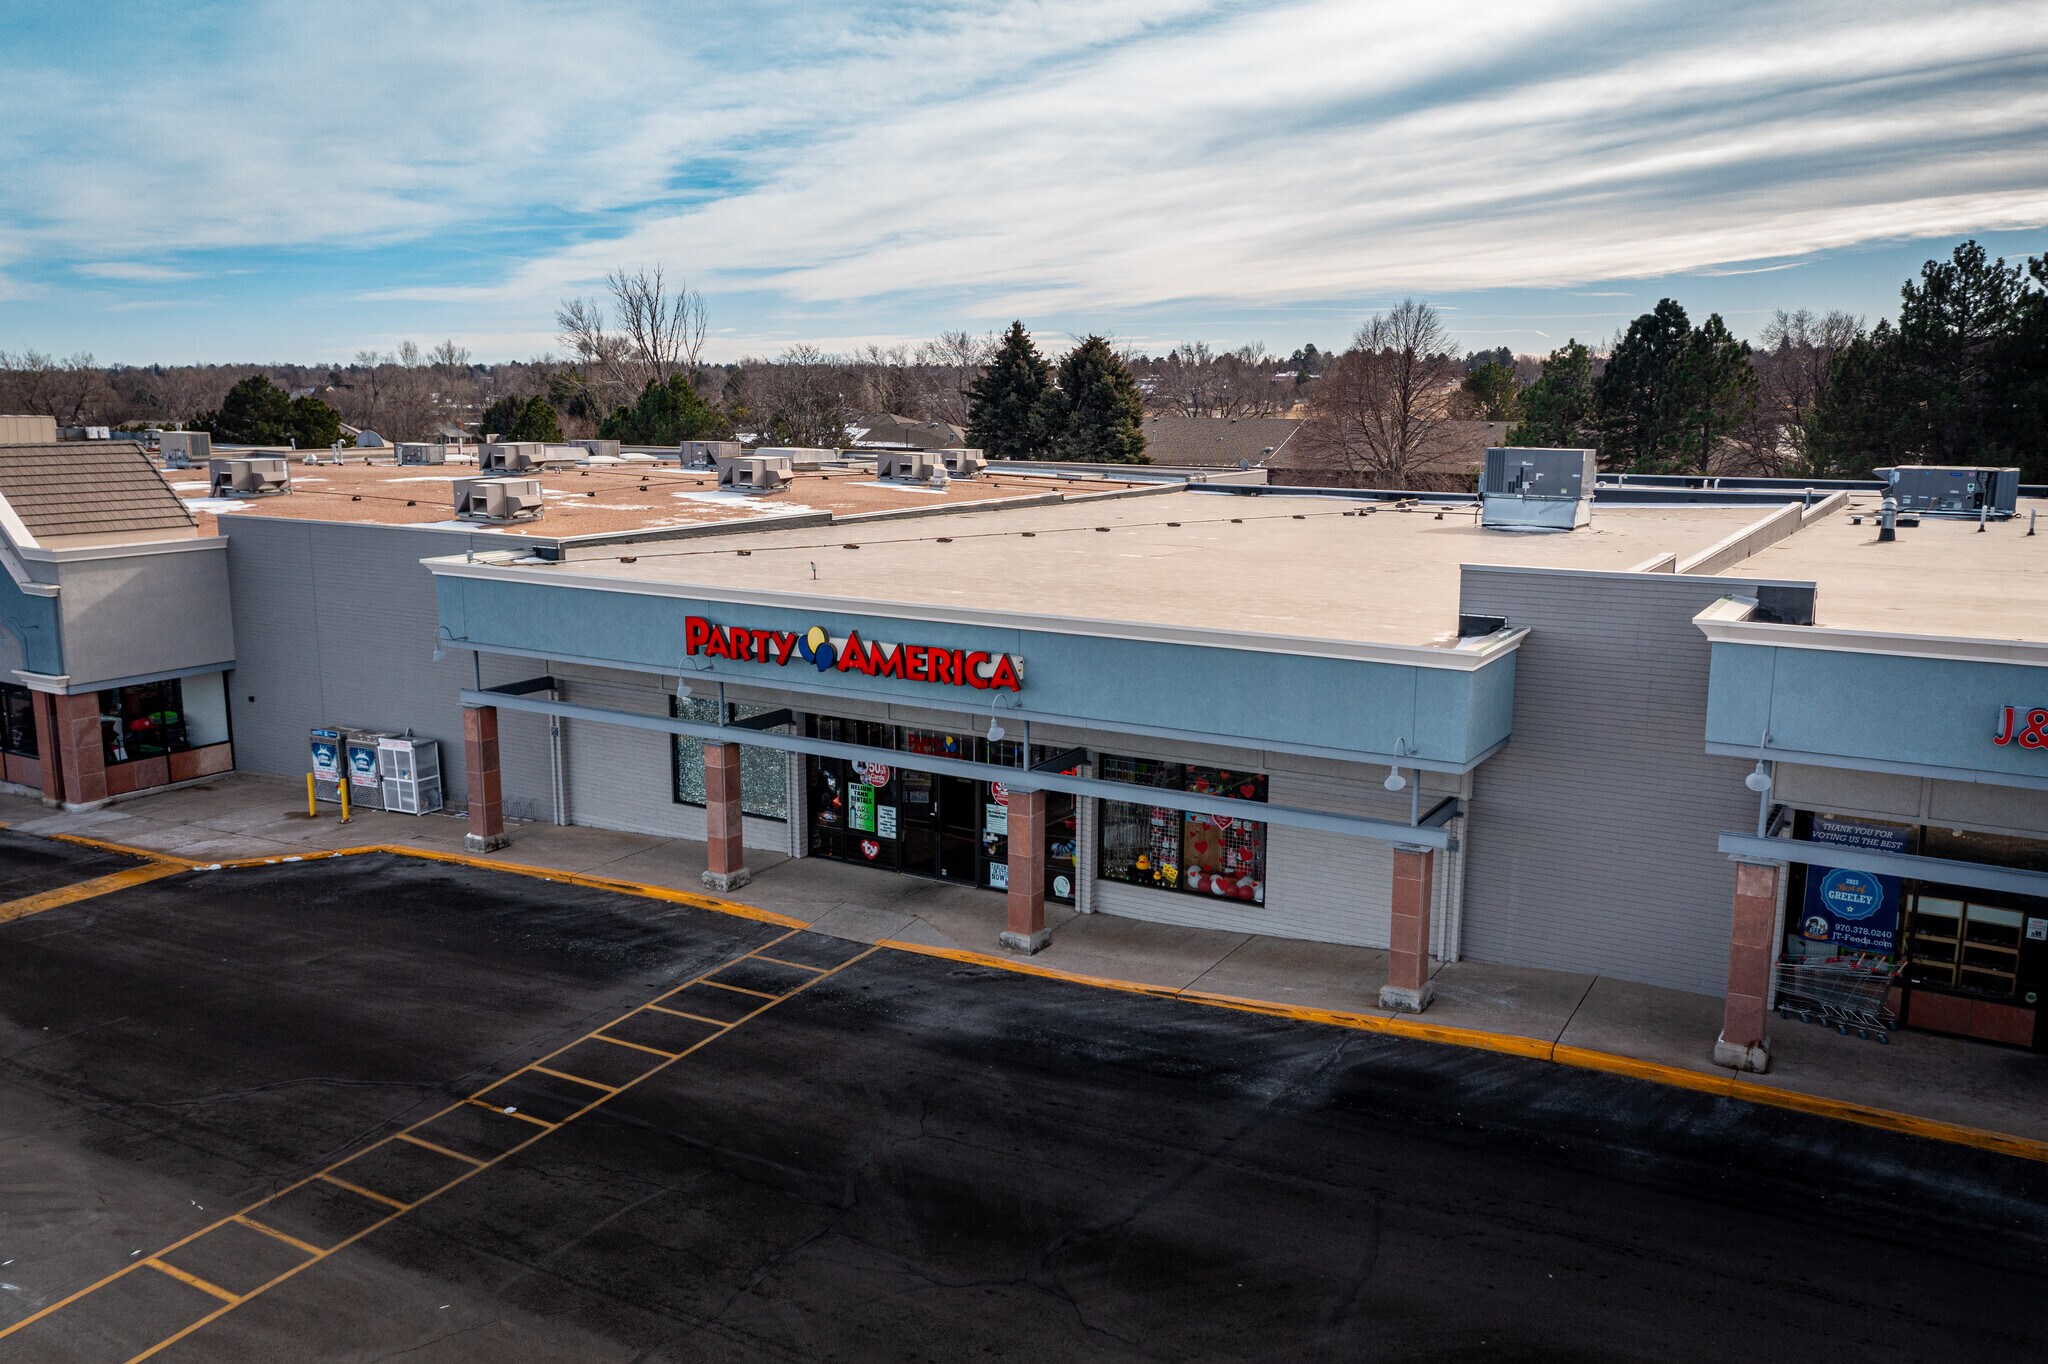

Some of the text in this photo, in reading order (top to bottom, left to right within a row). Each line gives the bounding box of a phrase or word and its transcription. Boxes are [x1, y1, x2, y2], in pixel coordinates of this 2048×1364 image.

[685, 616, 1024, 692] PARTY AMERICA
[850, 784, 872, 792] HELIUM
[850, 795, 873, 804] RENTALS
[1823, 823, 1893, 839] THANK YOU FOR
[1812, 830, 1847, 842] VOTING
[1848, 836, 1860, 844] US
[1861, 837, 1880, 846] THE
[1880, 840, 1903, 849] BEST
[862, 840, 878, 856] ty
[1836, 882, 1867, 894] Best of
[1828, 890, 1873, 904] GREELEY
[1835, 923, 1892, 939] 970.378.0240
[1832, 932, 1893, 948] JT-Feeds.com
